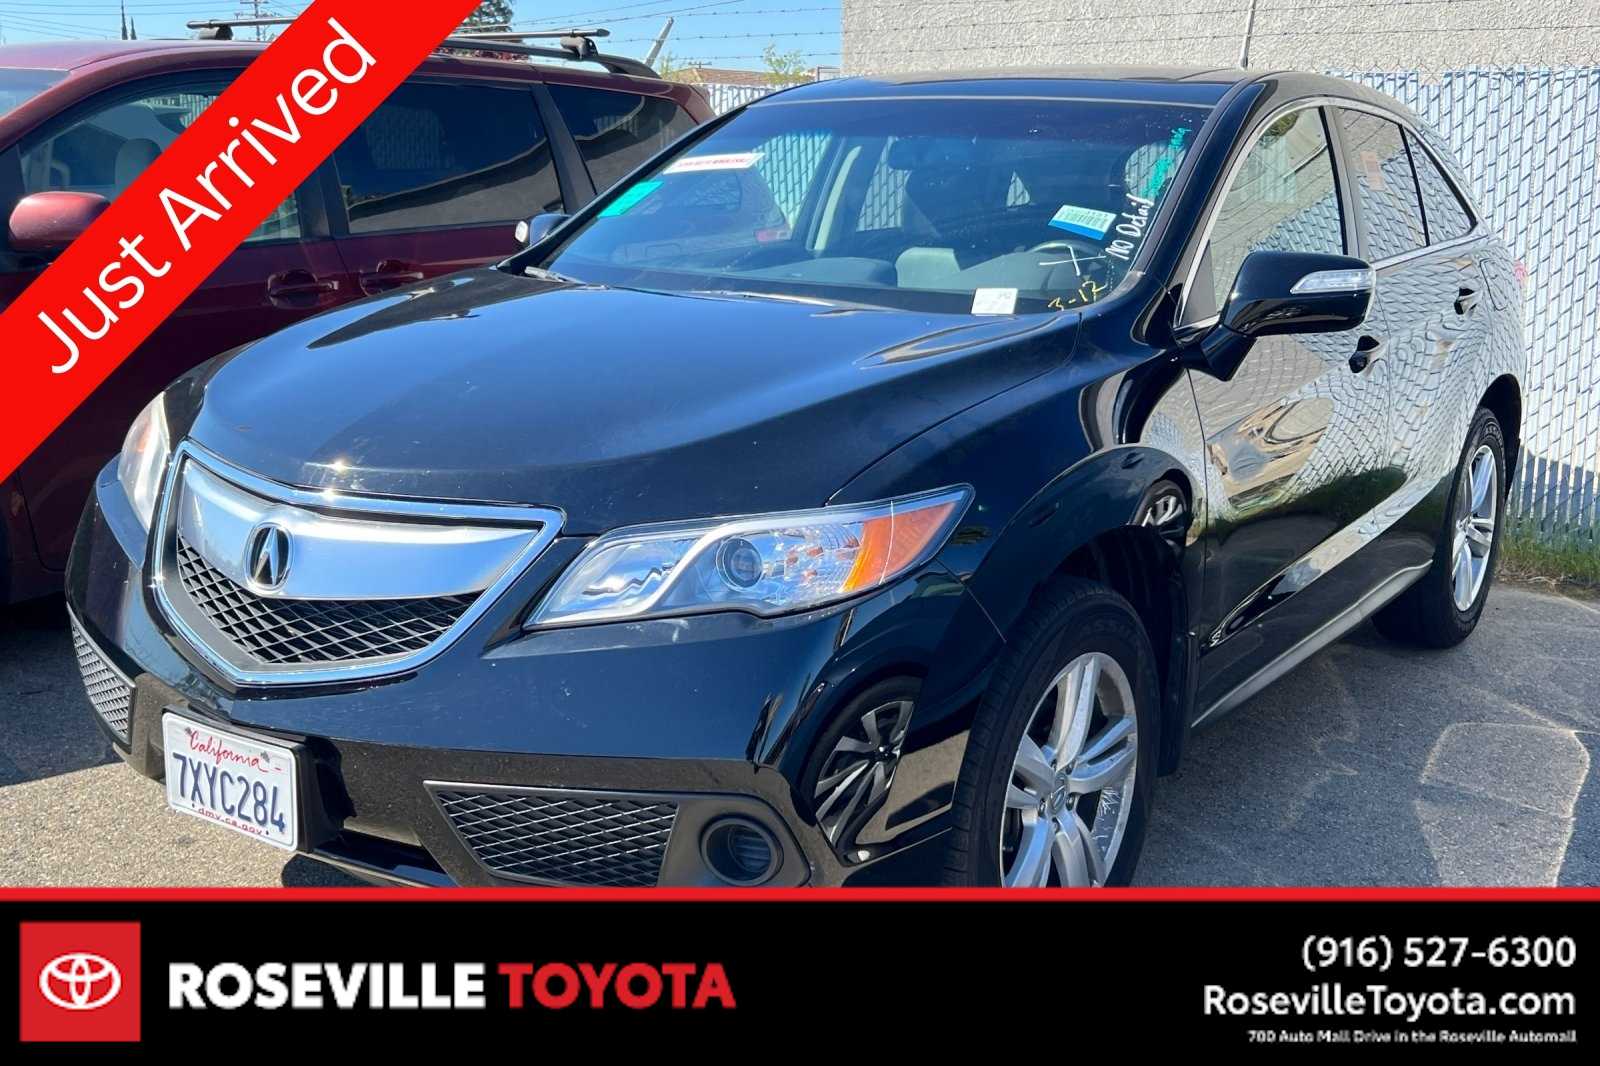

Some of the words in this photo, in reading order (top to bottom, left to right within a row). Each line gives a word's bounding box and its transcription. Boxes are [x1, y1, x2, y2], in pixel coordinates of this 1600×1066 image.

[190, 730, 268, 772] California
[172, 752, 286, 833] 7XYC284
[198, 807, 263, 836] dmv.ca.gov
